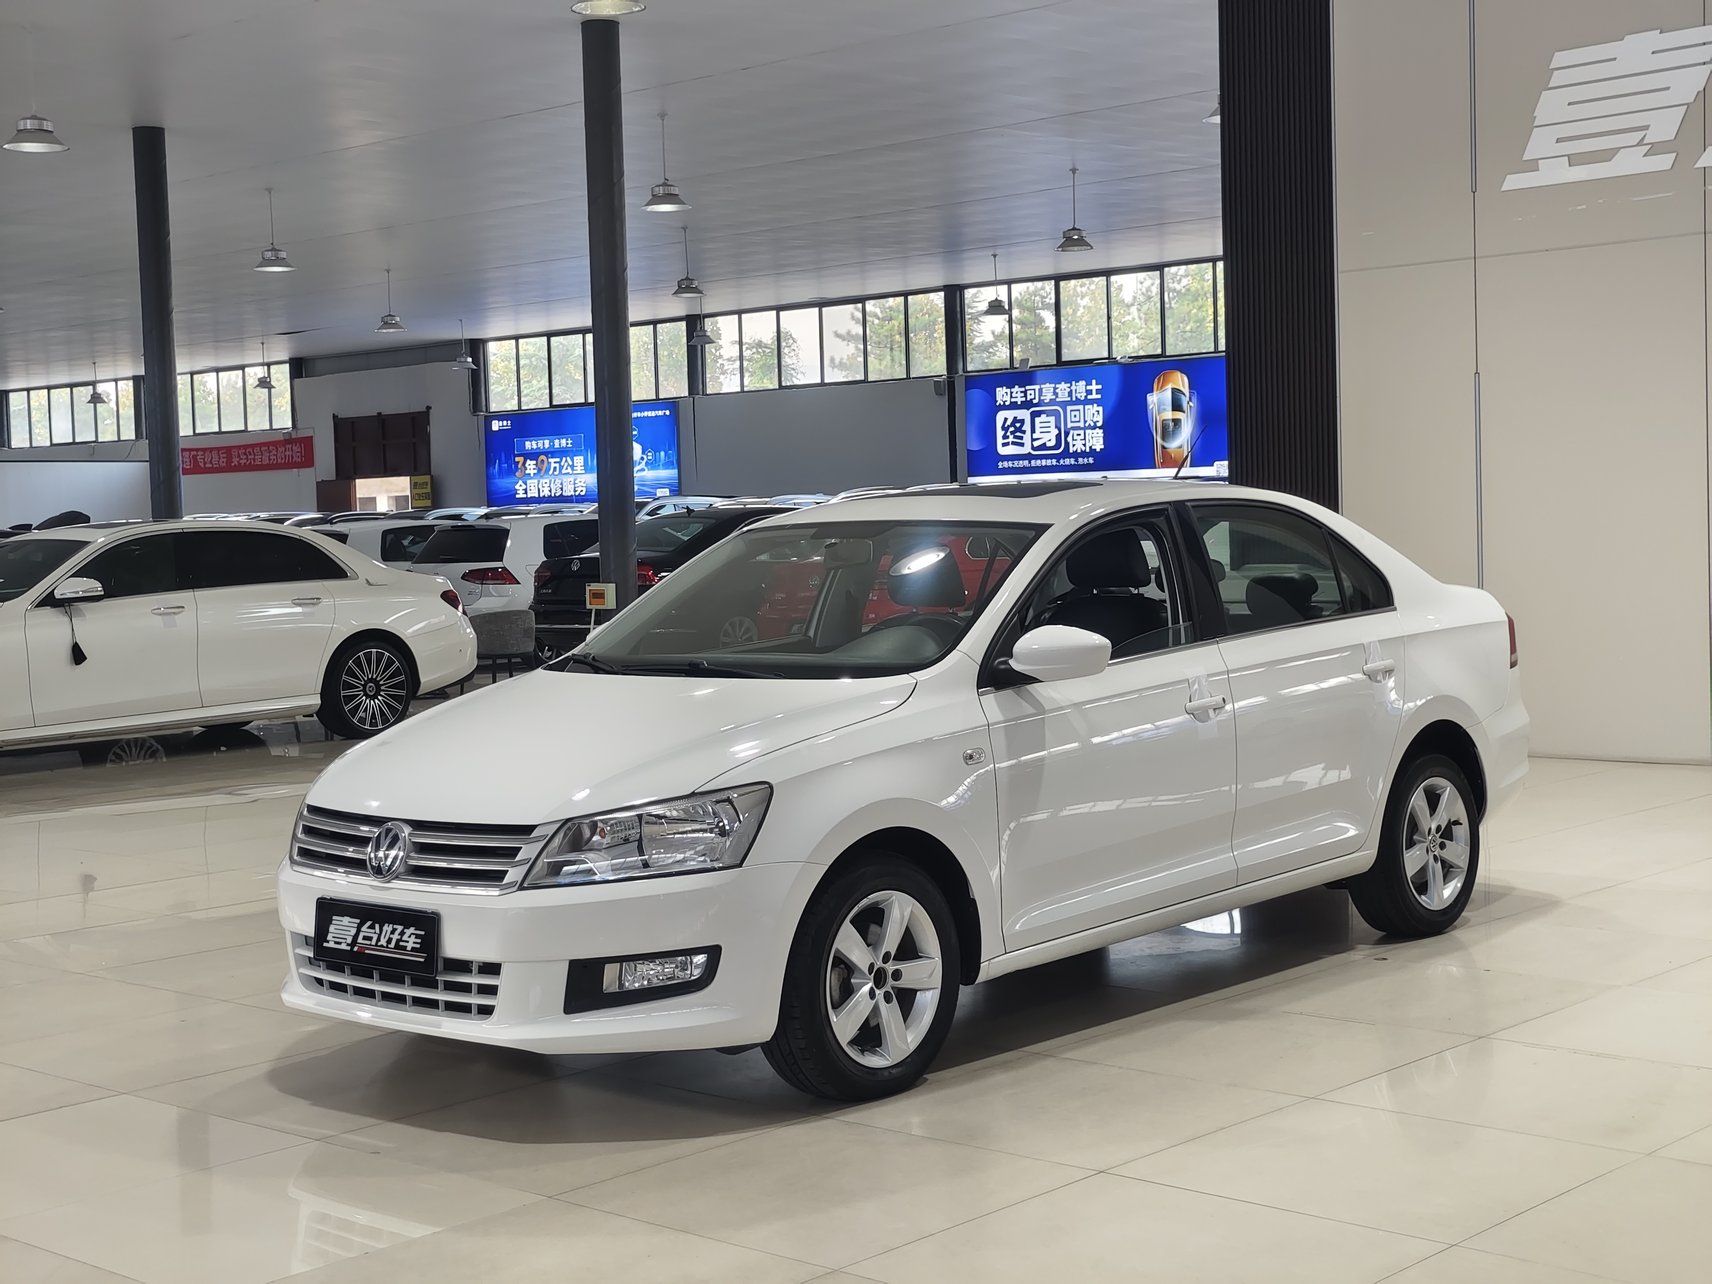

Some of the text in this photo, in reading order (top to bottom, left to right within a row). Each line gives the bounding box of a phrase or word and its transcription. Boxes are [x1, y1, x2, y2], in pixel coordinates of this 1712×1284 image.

[1501, 24, 1712, 191] 壹
[996, 379, 1102, 405] 购车可享查博士
[1066, 403, 1103, 428] 回购
[1000, 413, 1060, 448] 终身
[1067, 429, 1104, 453] 保障
[515, 455, 585, 478] 3年9万公里
[515, 478, 586, 498] 全国保修服务
[323, 915, 425, 951] 壹台好车
